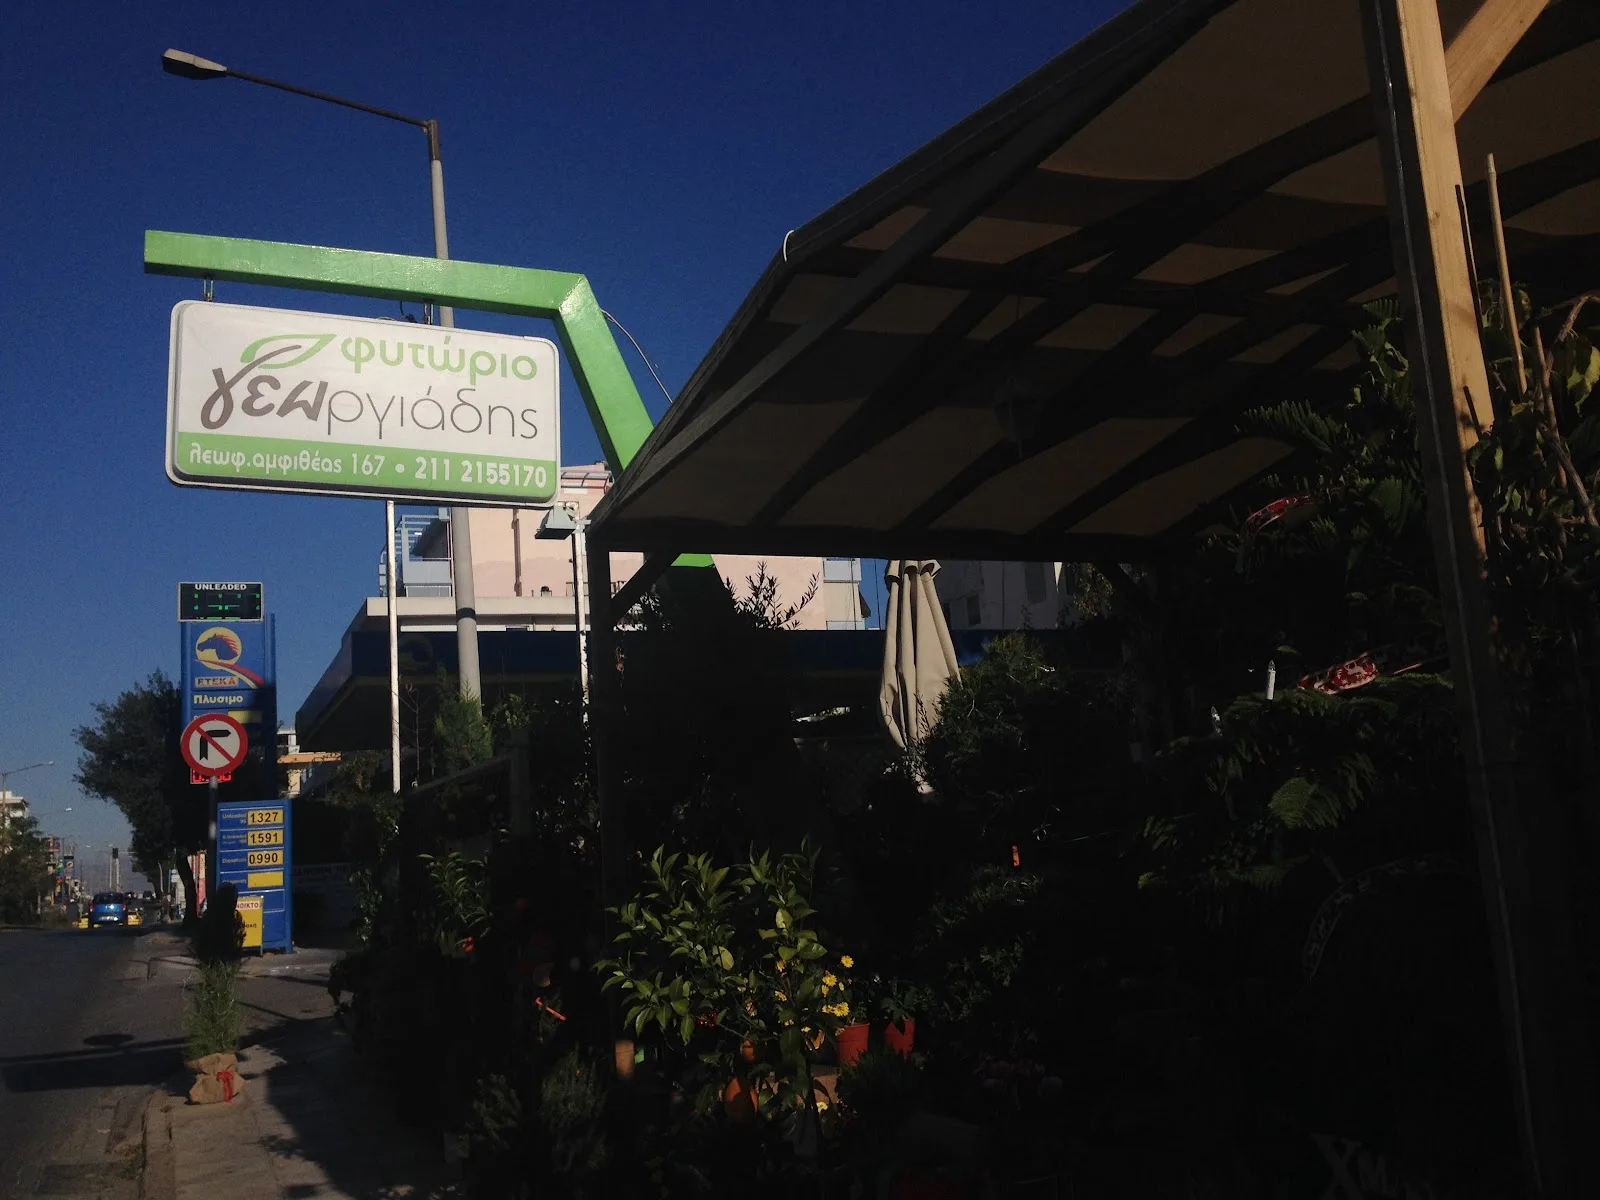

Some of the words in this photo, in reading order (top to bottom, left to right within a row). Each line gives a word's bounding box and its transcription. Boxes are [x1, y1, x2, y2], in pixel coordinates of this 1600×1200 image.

[340, 335, 539, 385] φυτώριο
[200, 345, 539, 439] γεωργιάδης
[350, 452, 385, 477] 167
[414, 456, 451, 481] 211
[460, 459, 548, 489] 2155170
[194, 583, 247, 591] UNLEADED
